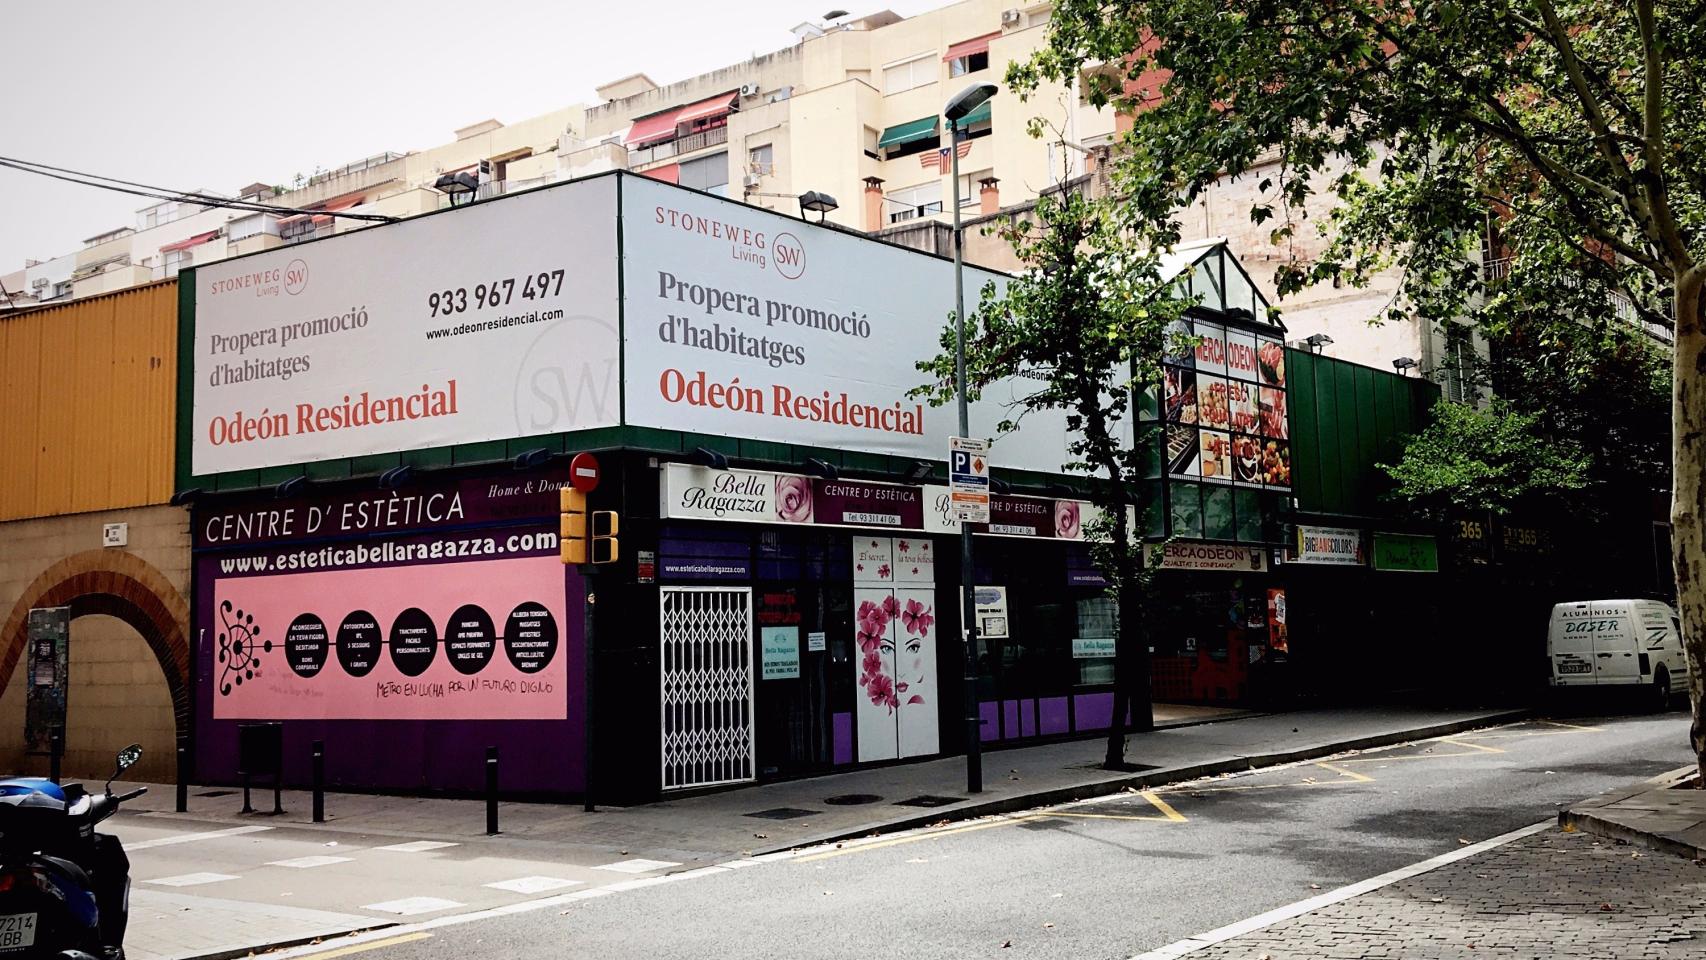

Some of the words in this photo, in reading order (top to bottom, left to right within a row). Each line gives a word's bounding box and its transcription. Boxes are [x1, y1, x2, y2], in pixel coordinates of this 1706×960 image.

[656, 206, 765, 249] STONEWEG
[732, 245, 766, 269] Living
[776, 244, 800, 267] SW
[211, 268, 280, 295] STONEWEG
[287, 269, 305, 286] SW
[256, 285, 279, 297] Living
[428, 288, 467, 318] 933
[475, 278, 515, 310] 967
[522, 269, 565, 301] 497
[658, 271, 760, 317] Propera
[766, 299, 871, 338] promoció
[210, 327, 277, 354] Propera
[281, 305, 369, 347] promoció
[426, 308, 564, 340] www.odeonresidencial.com
[658, 315, 805, 368] d'habitatges
[209, 354, 311, 387] d'habitatges
[209, 410, 289, 446] Odeón
[295, 379, 459, 434] Residencial
[659, 368, 763, 417] Odeón
[771, 384, 924, 436] Residencial
[955, 452, 966, 471] P
[487, 484, 520, 498] Home
[524, 481, 533, 494] &
[713, 473, 765, 496] Bella
[824, 485, 860, 498] CENTRE
[875, 488, 915, 502] ESTÈTICA
[681, 486, 766, 517] Ragazza
[990, 501, 1003, 512] TRE
[1015, 502, 1048, 515] ESTÈTICA
[205, 508, 295, 542] CENTRE
[306, 505, 332, 534] D'
[340, 490, 464, 531] ESTÈTICA
[860, 514, 868, 522] 93
[869, 515, 879, 523] 311
[888, 516, 896, 524] 06
[1460, 520, 1482, 539] 365
[1520, 528, 1537, 546] 365
[220, 532, 557, 574] www.esteticabellaragazza.com
[1163, 545, 1244, 561] ERCAODEON
[664, 565, 746, 575] www.esteticabellaragazza.com
[1562, 609, 1619, 618] ALUMINIOS
[1565, 620, 1619, 633] DASER
[376, 681, 402, 698] METRO
[404, 682, 417, 696] EN
[418, 682, 444, 697] LUCHA
[449, 680, 465, 692] POR
[467, 677, 479, 692] UN
[482, 679, 517, 694] FUTURO
[520, 680, 553, 694] DIGNO
[0, 916, 33, 932] 7214
